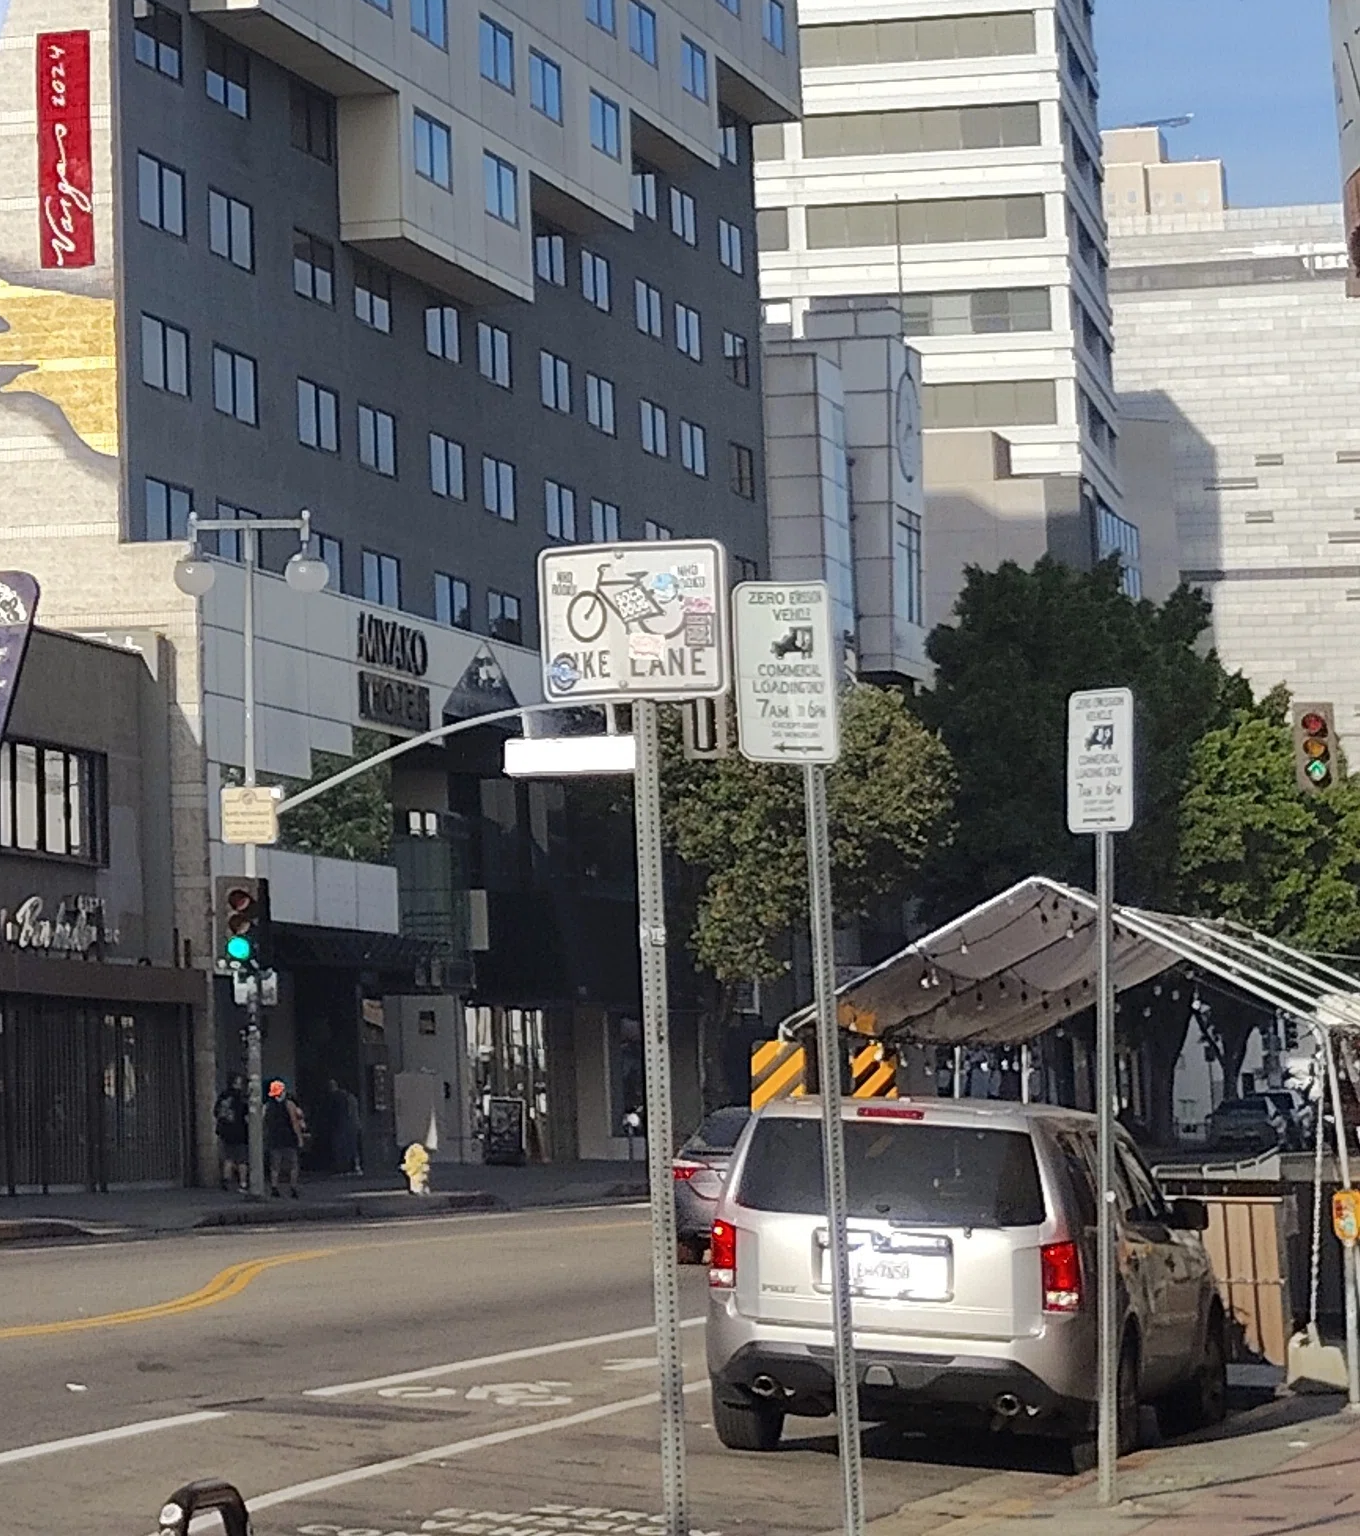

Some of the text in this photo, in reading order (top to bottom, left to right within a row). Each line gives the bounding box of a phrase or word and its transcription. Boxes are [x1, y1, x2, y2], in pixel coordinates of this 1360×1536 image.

[47, 44, 66, 107] 2024
[747, 591, 785, 605] ZERO
[357, 610, 429, 677] MIYAKO
[630, 647, 707, 677] LANE
